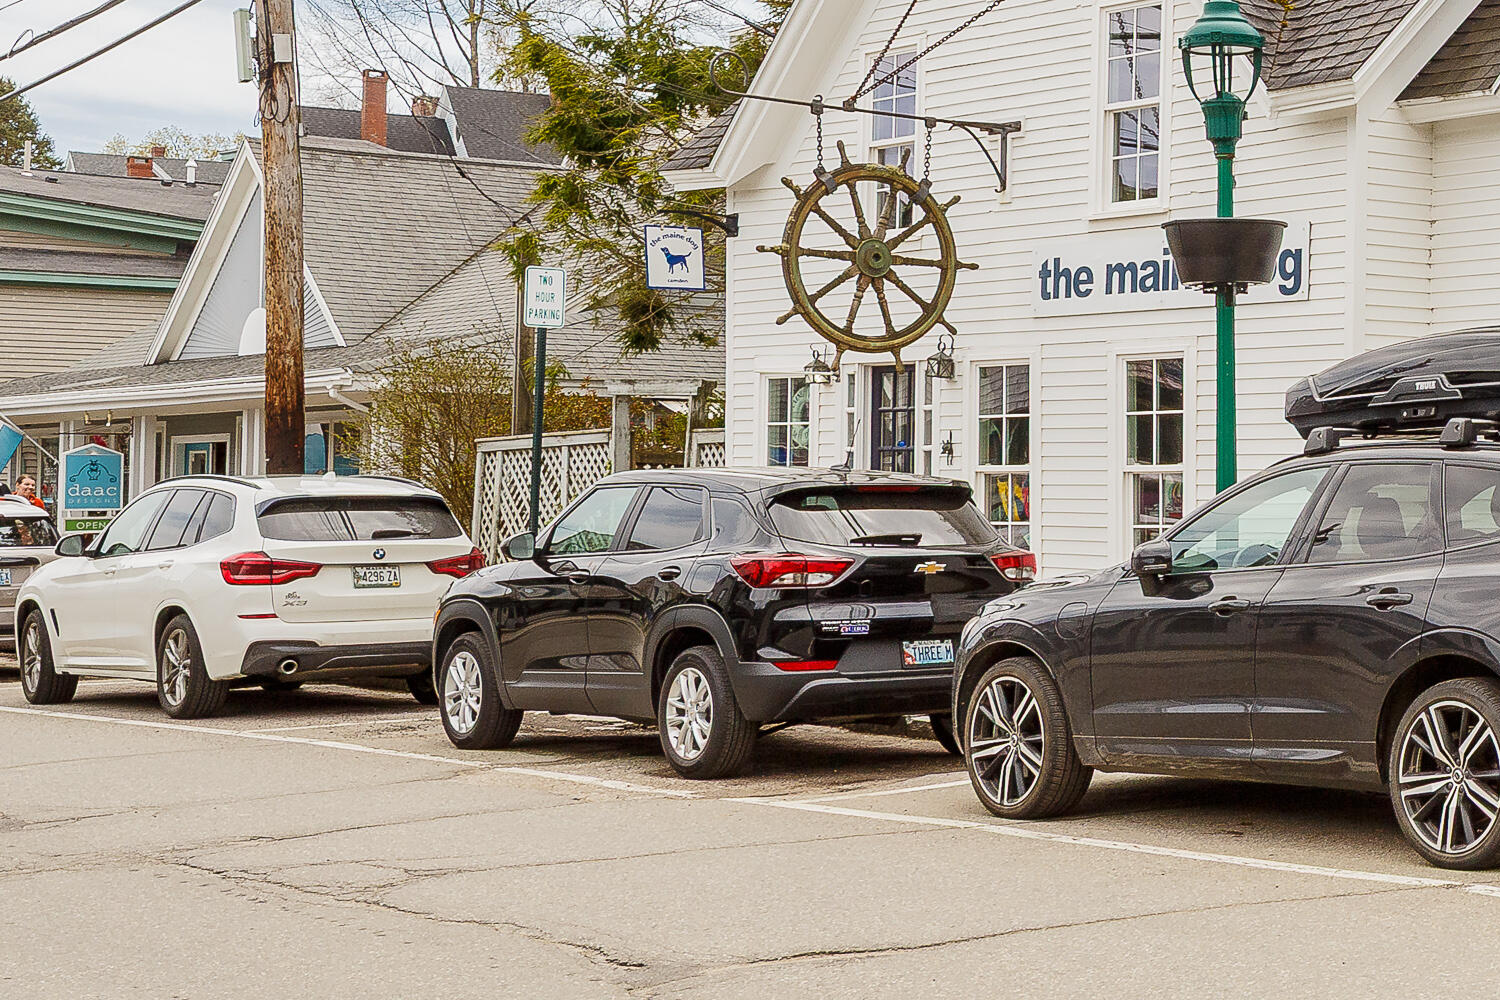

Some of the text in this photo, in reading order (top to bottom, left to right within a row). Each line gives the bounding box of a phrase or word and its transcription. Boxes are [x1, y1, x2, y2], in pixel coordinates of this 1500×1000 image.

[649, 231, 699, 251] the maine dog
[1038, 247, 1195, 300] the mai
[539, 275, 553, 286] TWO
[535, 291, 556, 303] HOUR
[528, 308, 560, 320] PARKING
[67, 483, 117, 497] daac
[76, 521, 106, 530] OPEN
[362, 570, 399, 582] 4296 ZA
[911, 643, 953, 661] THREE M
